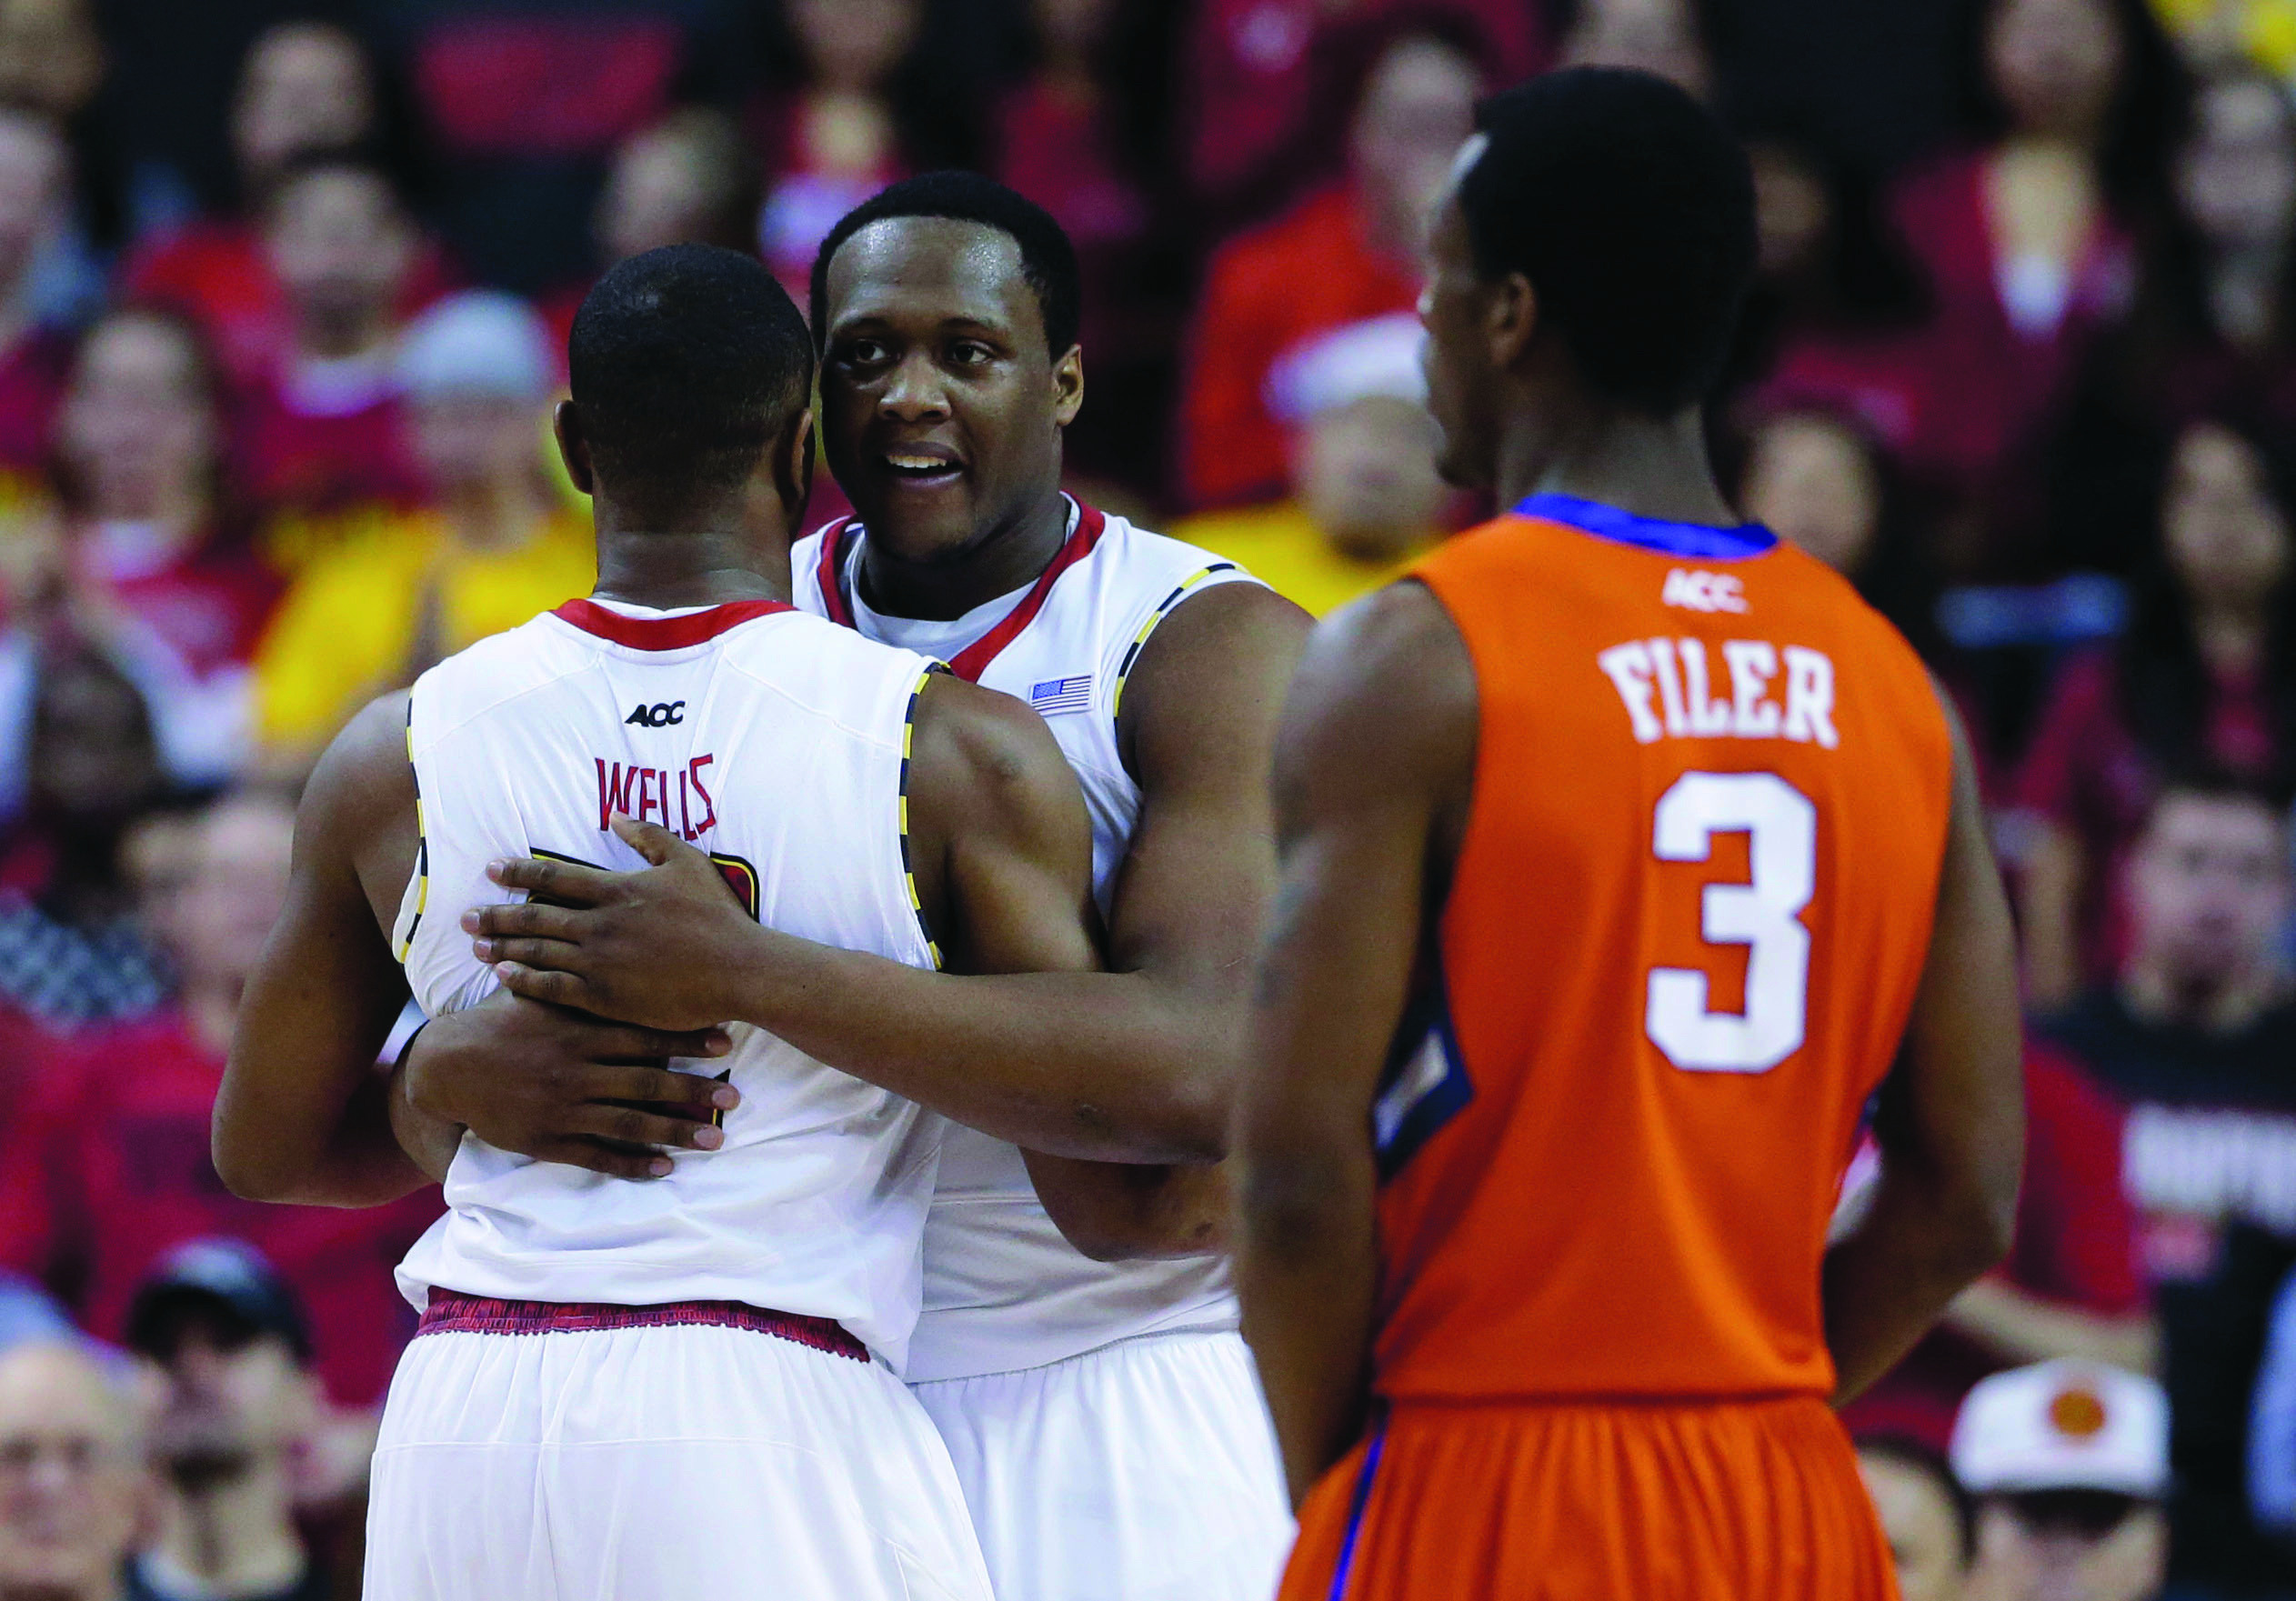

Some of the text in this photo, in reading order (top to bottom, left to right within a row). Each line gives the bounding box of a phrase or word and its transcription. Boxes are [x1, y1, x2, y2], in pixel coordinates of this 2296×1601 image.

[625, 701, 686, 727] ACC
[1598, 636, 1839, 749] FILER
[595, 753, 717, 842] WELLS
[1645, 770, 1817, 1073] 3
